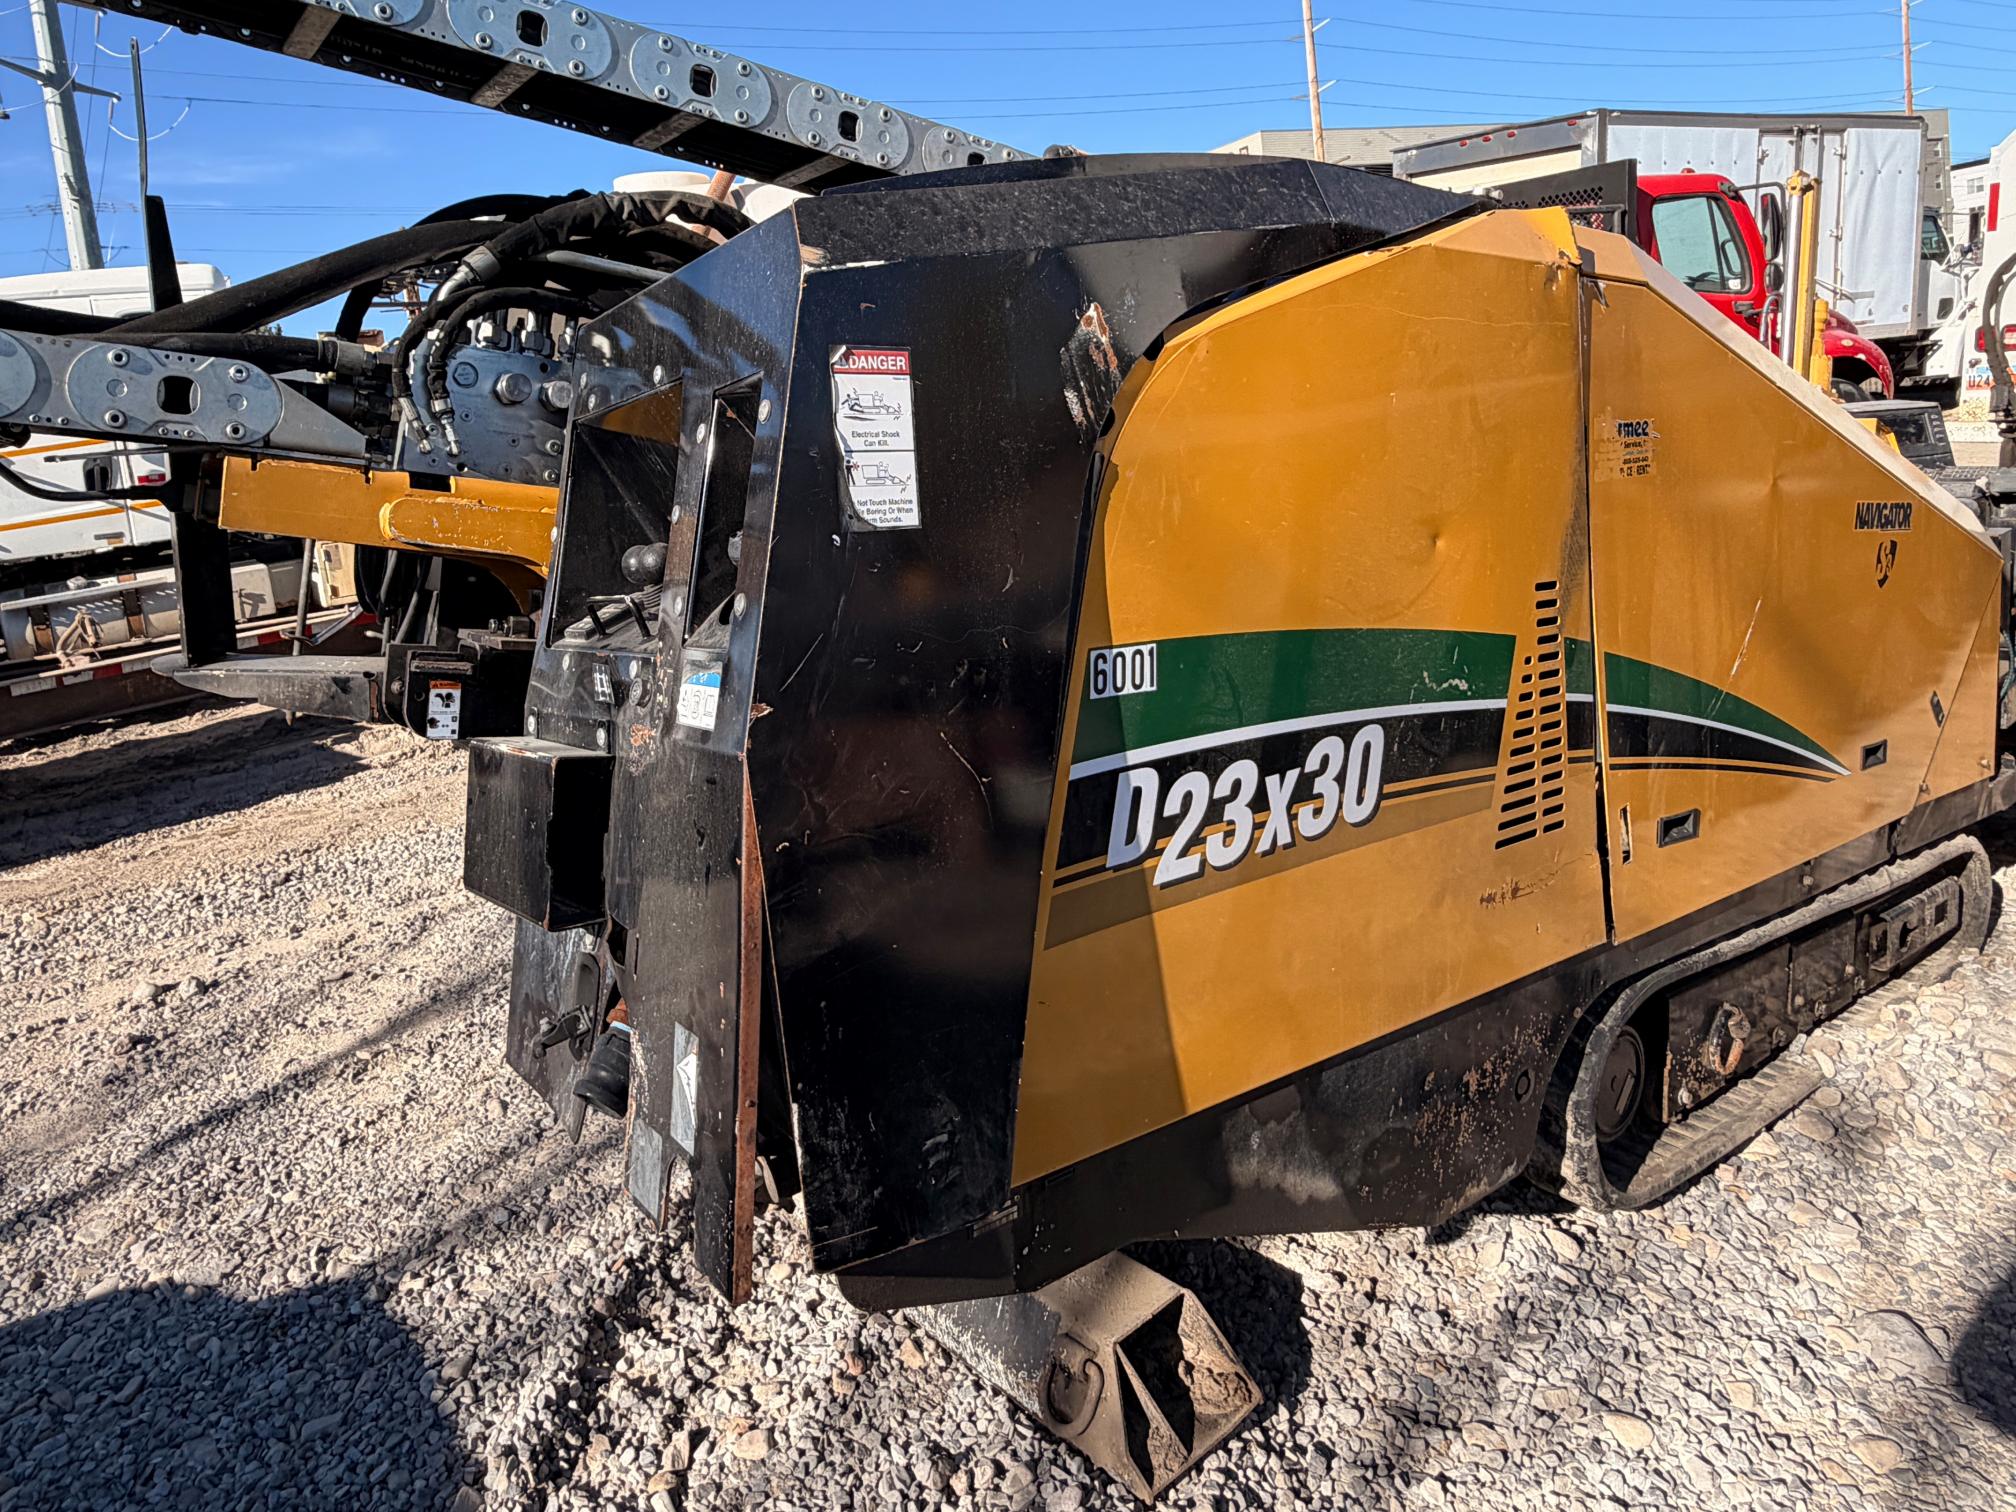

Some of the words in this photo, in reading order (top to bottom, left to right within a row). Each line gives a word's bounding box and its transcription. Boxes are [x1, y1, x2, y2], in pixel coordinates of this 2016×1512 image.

[849, 354, 906, 370] DANGER
[851, 430, 880, 438] Electrical
[881, 430, 900, 438] Shock
[857, 499, 868, 507] Not
[869, 498, 887, 506] Touch
[888, 497, 914, 506] Machine
[866, 507, 886, 516] Boring
[896, 506, 913, 514] When
[1854, 502, 1912, 530] NAVIGATOR
[878, 516, 904, 524] Sounds.
[1093, 645, 1156, 696] 6001
[1105, 723, 1386, 889] D23x30
